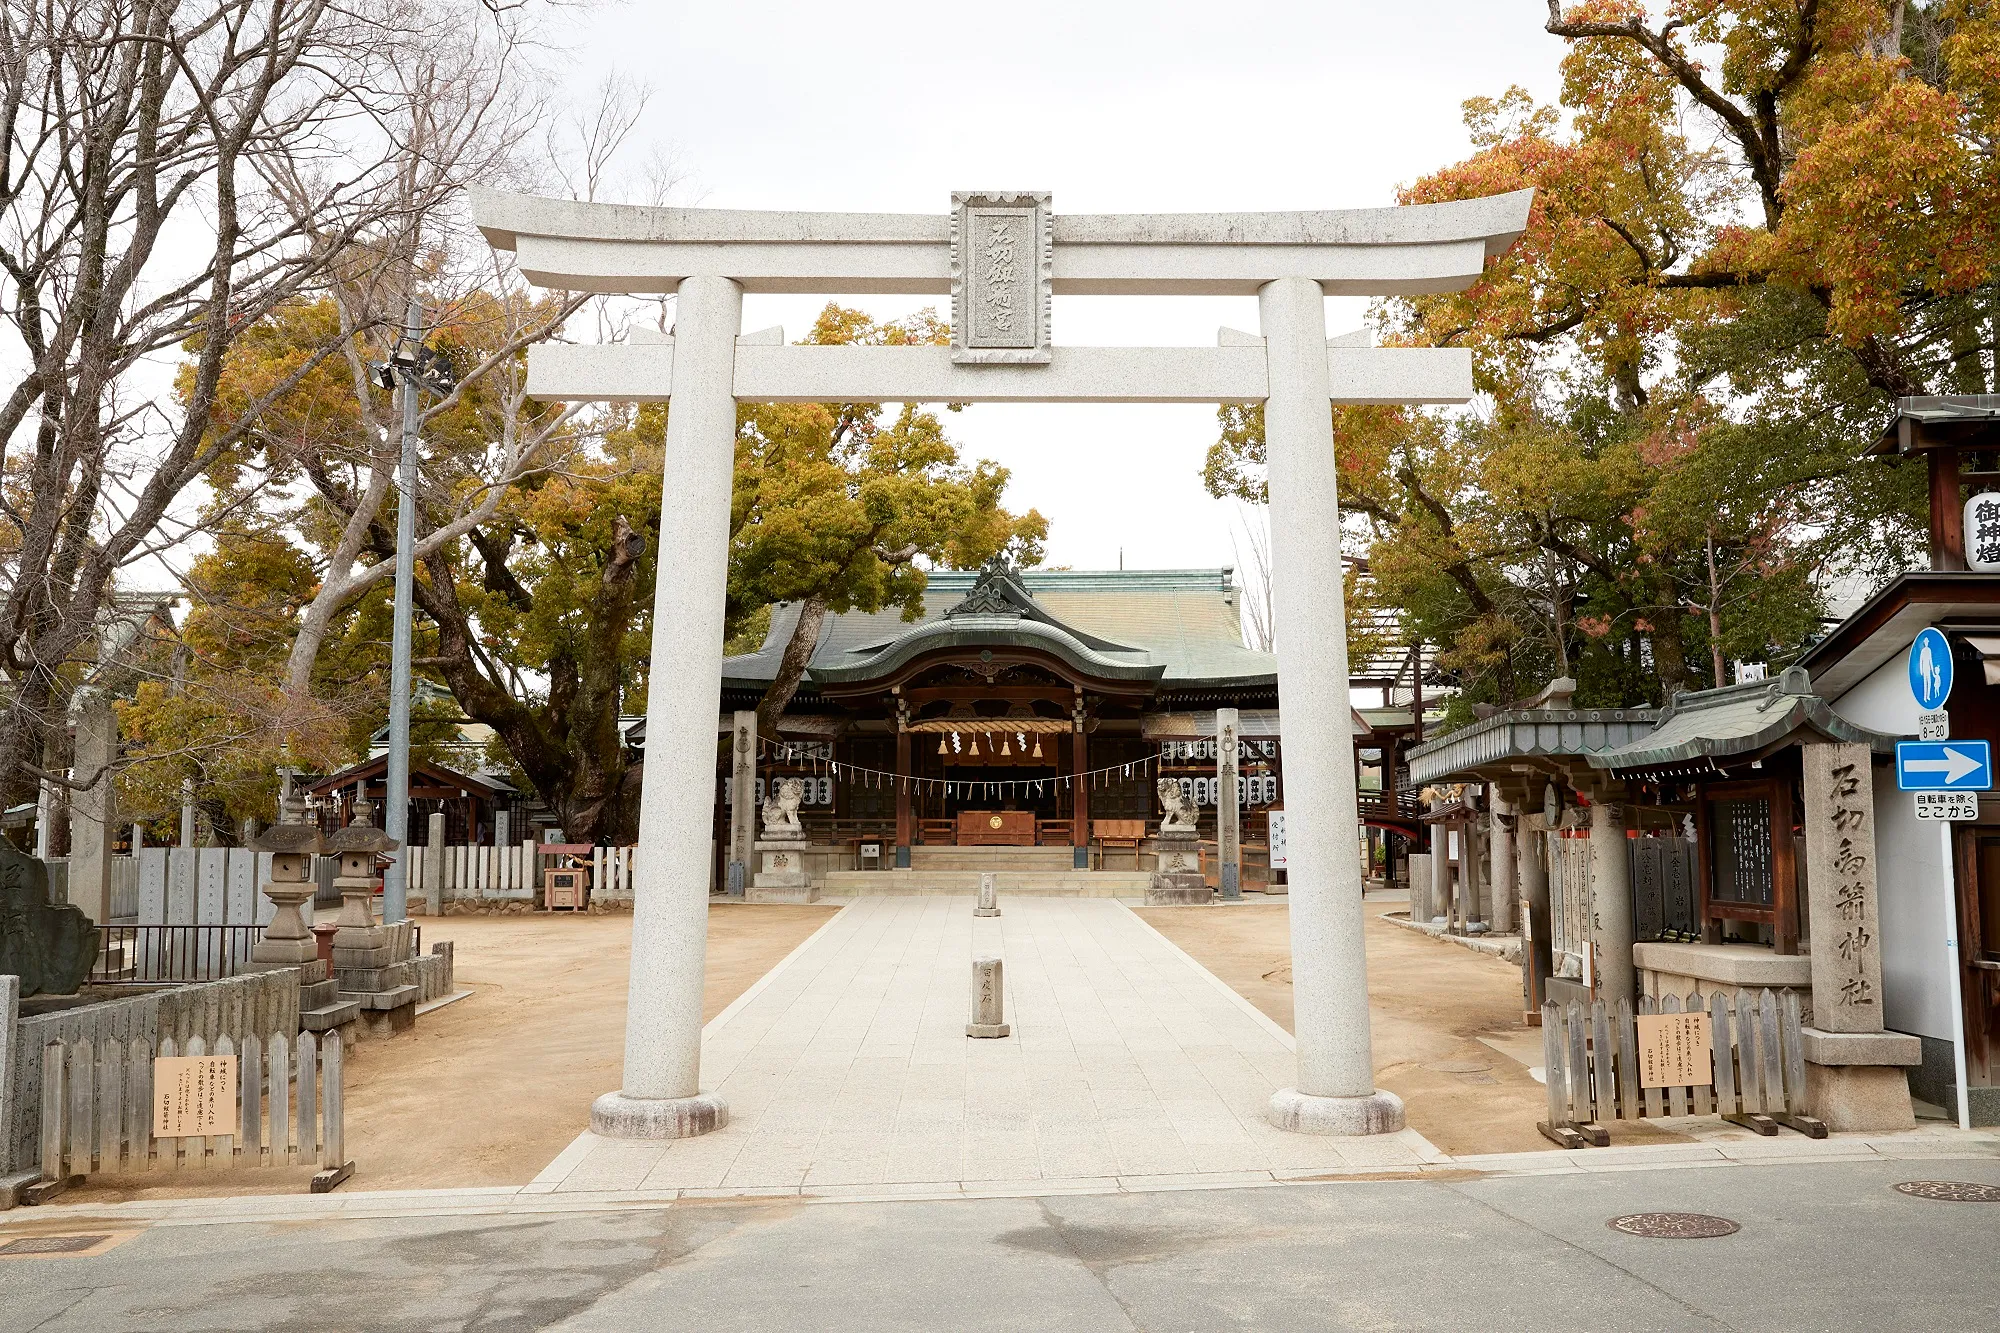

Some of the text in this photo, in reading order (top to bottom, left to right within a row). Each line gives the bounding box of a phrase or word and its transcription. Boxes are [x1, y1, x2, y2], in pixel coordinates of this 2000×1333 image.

[1917, 794, 1974, 804] 自転車を除く
[1918, 805, 1976, 818] ここから
[220, 1060, 228, 1092] 神域につき
